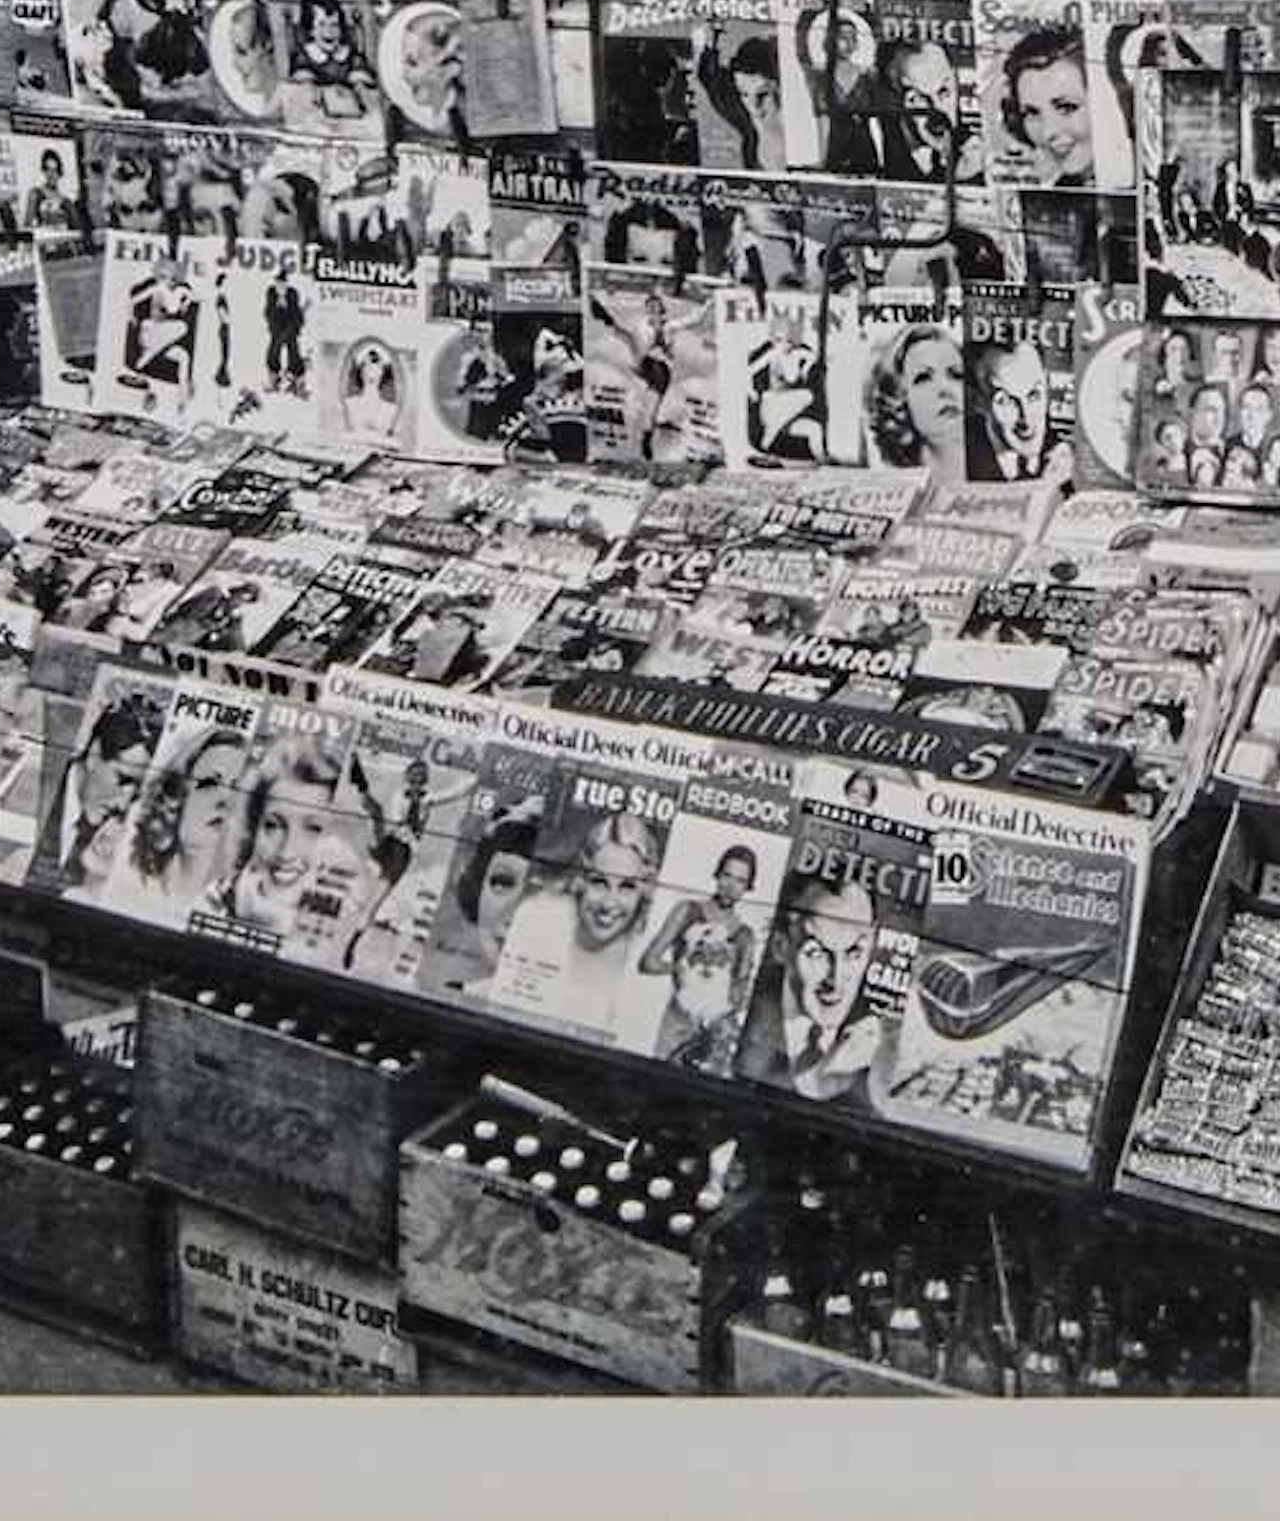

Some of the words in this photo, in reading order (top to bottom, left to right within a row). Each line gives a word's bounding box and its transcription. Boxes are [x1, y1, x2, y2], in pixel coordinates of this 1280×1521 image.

[590, 537, 714, 581] Love
[1100, 608, 1221, 656] SPIDER
[784, 632, 913, 679] HORROR
[1072, 661, 1198, 705] SPIDER
[174, 692, 255, 731] PICTURE
[502, 711, 579, 750] Official
[685, 697, 838, 744] PHILLIES
[838, 720, 942, 766] CIGAR
[686, 783, 791, 828] REDBOOK
[926, 789, 1020, 834] Official
[1021, 808, 1137, 855] Detective
[934, 851, 968, 882] 10
[184, 1244, 234, 1282] CARL
[260, 1270, 350, 1321] SCHULTZ
